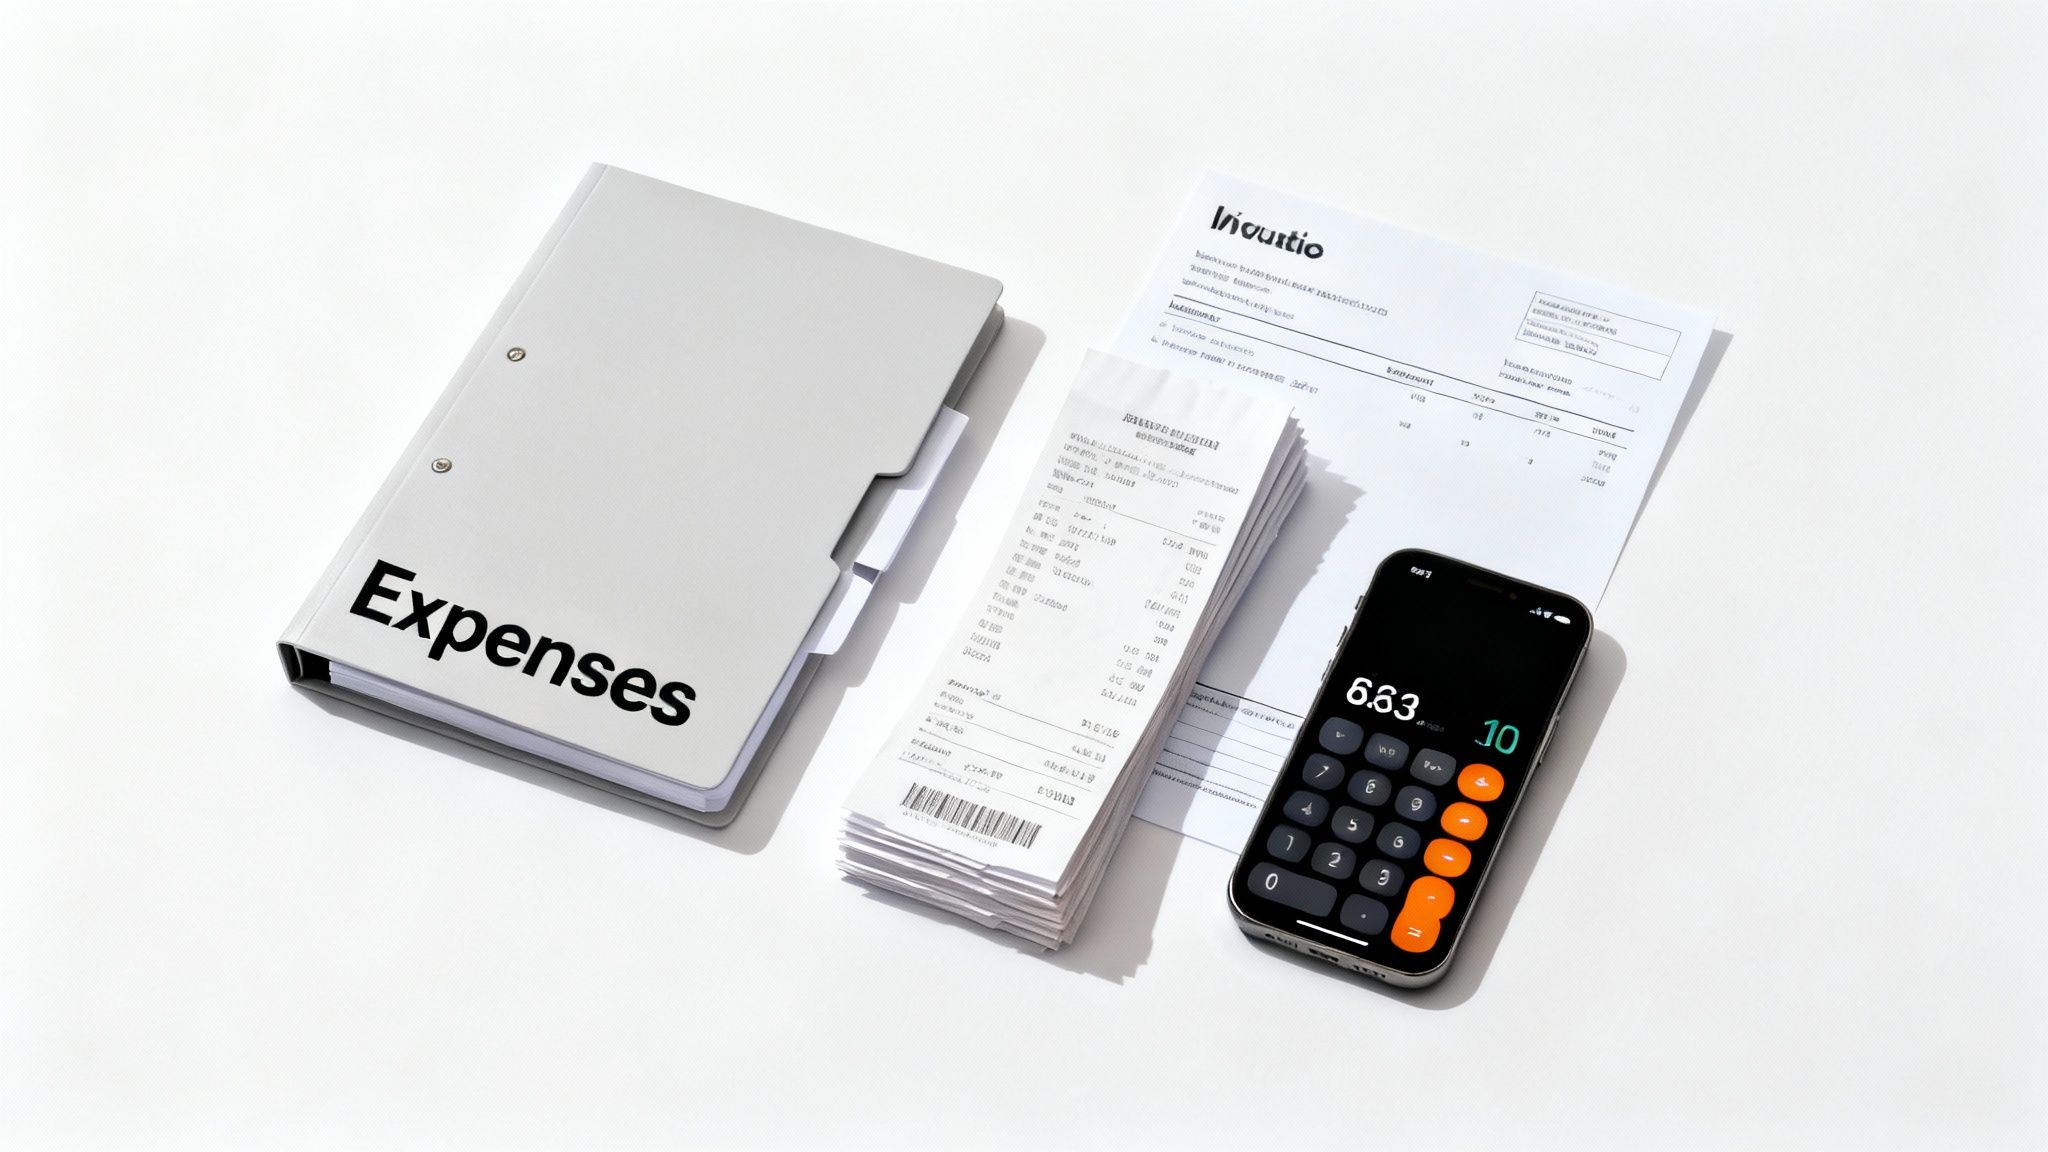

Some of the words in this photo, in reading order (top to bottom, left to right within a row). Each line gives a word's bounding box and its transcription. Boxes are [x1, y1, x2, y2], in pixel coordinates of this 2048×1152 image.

[349, 559, 697, 728] Expenses
[1328, 851, 1342, 869] 2
[1265, 872, 1279, 891] 0
